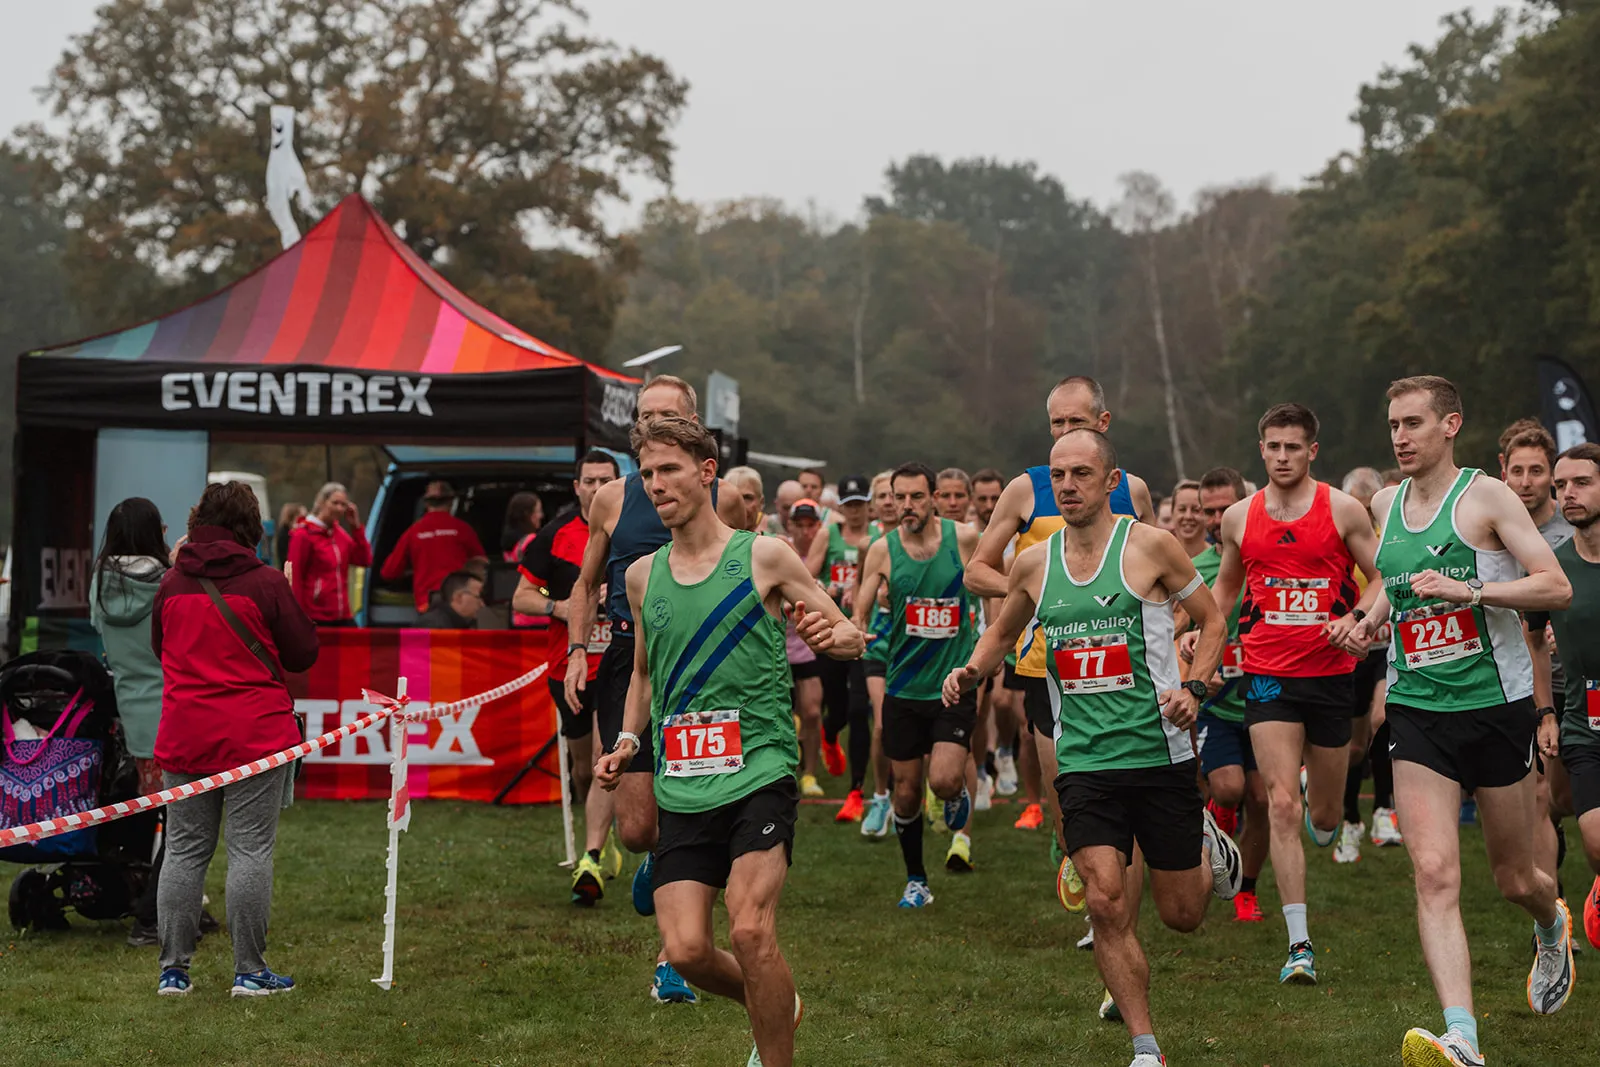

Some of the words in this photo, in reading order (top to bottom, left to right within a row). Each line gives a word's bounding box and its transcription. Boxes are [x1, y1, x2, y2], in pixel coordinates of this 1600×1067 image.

[161, 372, 433, 416] EVENTREX
[39, 547, 91, 608] EVEN
[1276, 590, 1318, 611] 126
[916, 607, 952, 627] 186
[1091, 616, 1137, 630] Valley
[1411, 616, 1463, 650] 224
[1073, 650, 1106, 677] 77
[676, 726, 726, 757] 175
